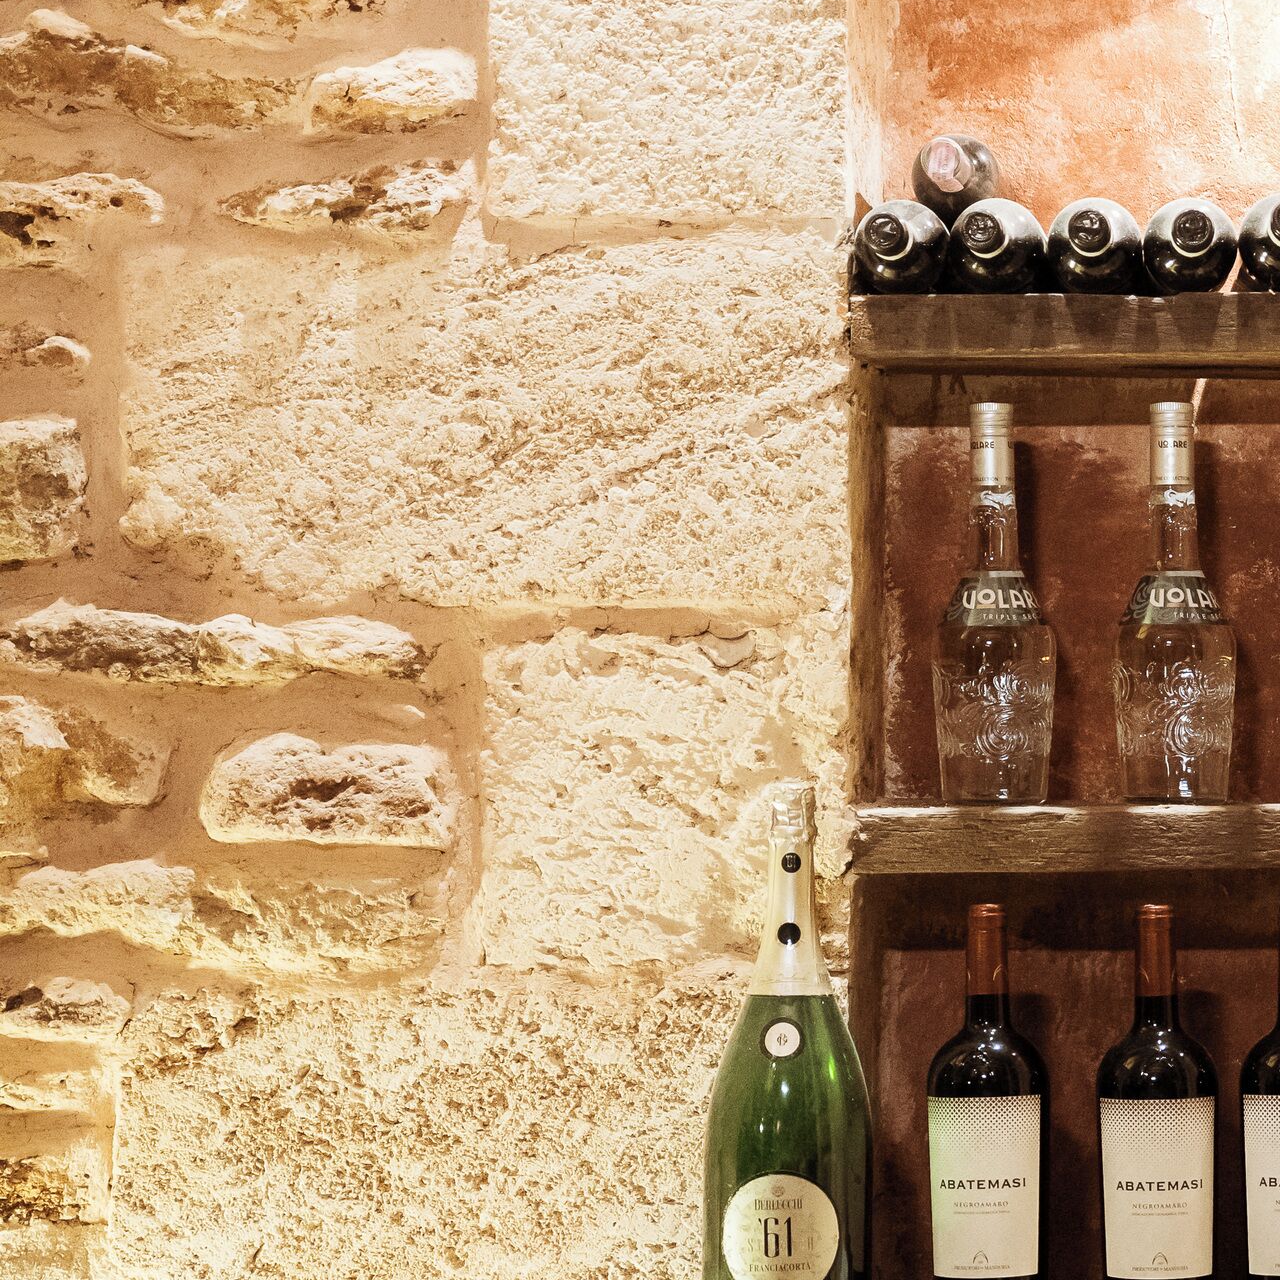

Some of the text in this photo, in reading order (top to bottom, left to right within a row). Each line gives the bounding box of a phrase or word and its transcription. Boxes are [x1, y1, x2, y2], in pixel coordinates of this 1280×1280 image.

[962, 588, 1041, 610] VOLAR
[940, 1178, 1026, 1190] ABATEMASI
[1116, 1179, 1203, 1191] ABATEMASI
[1132, 1202, 1188, 1210] NEGROAMARO
[749, 1262, 811, 1273] FRANCIACORTA
